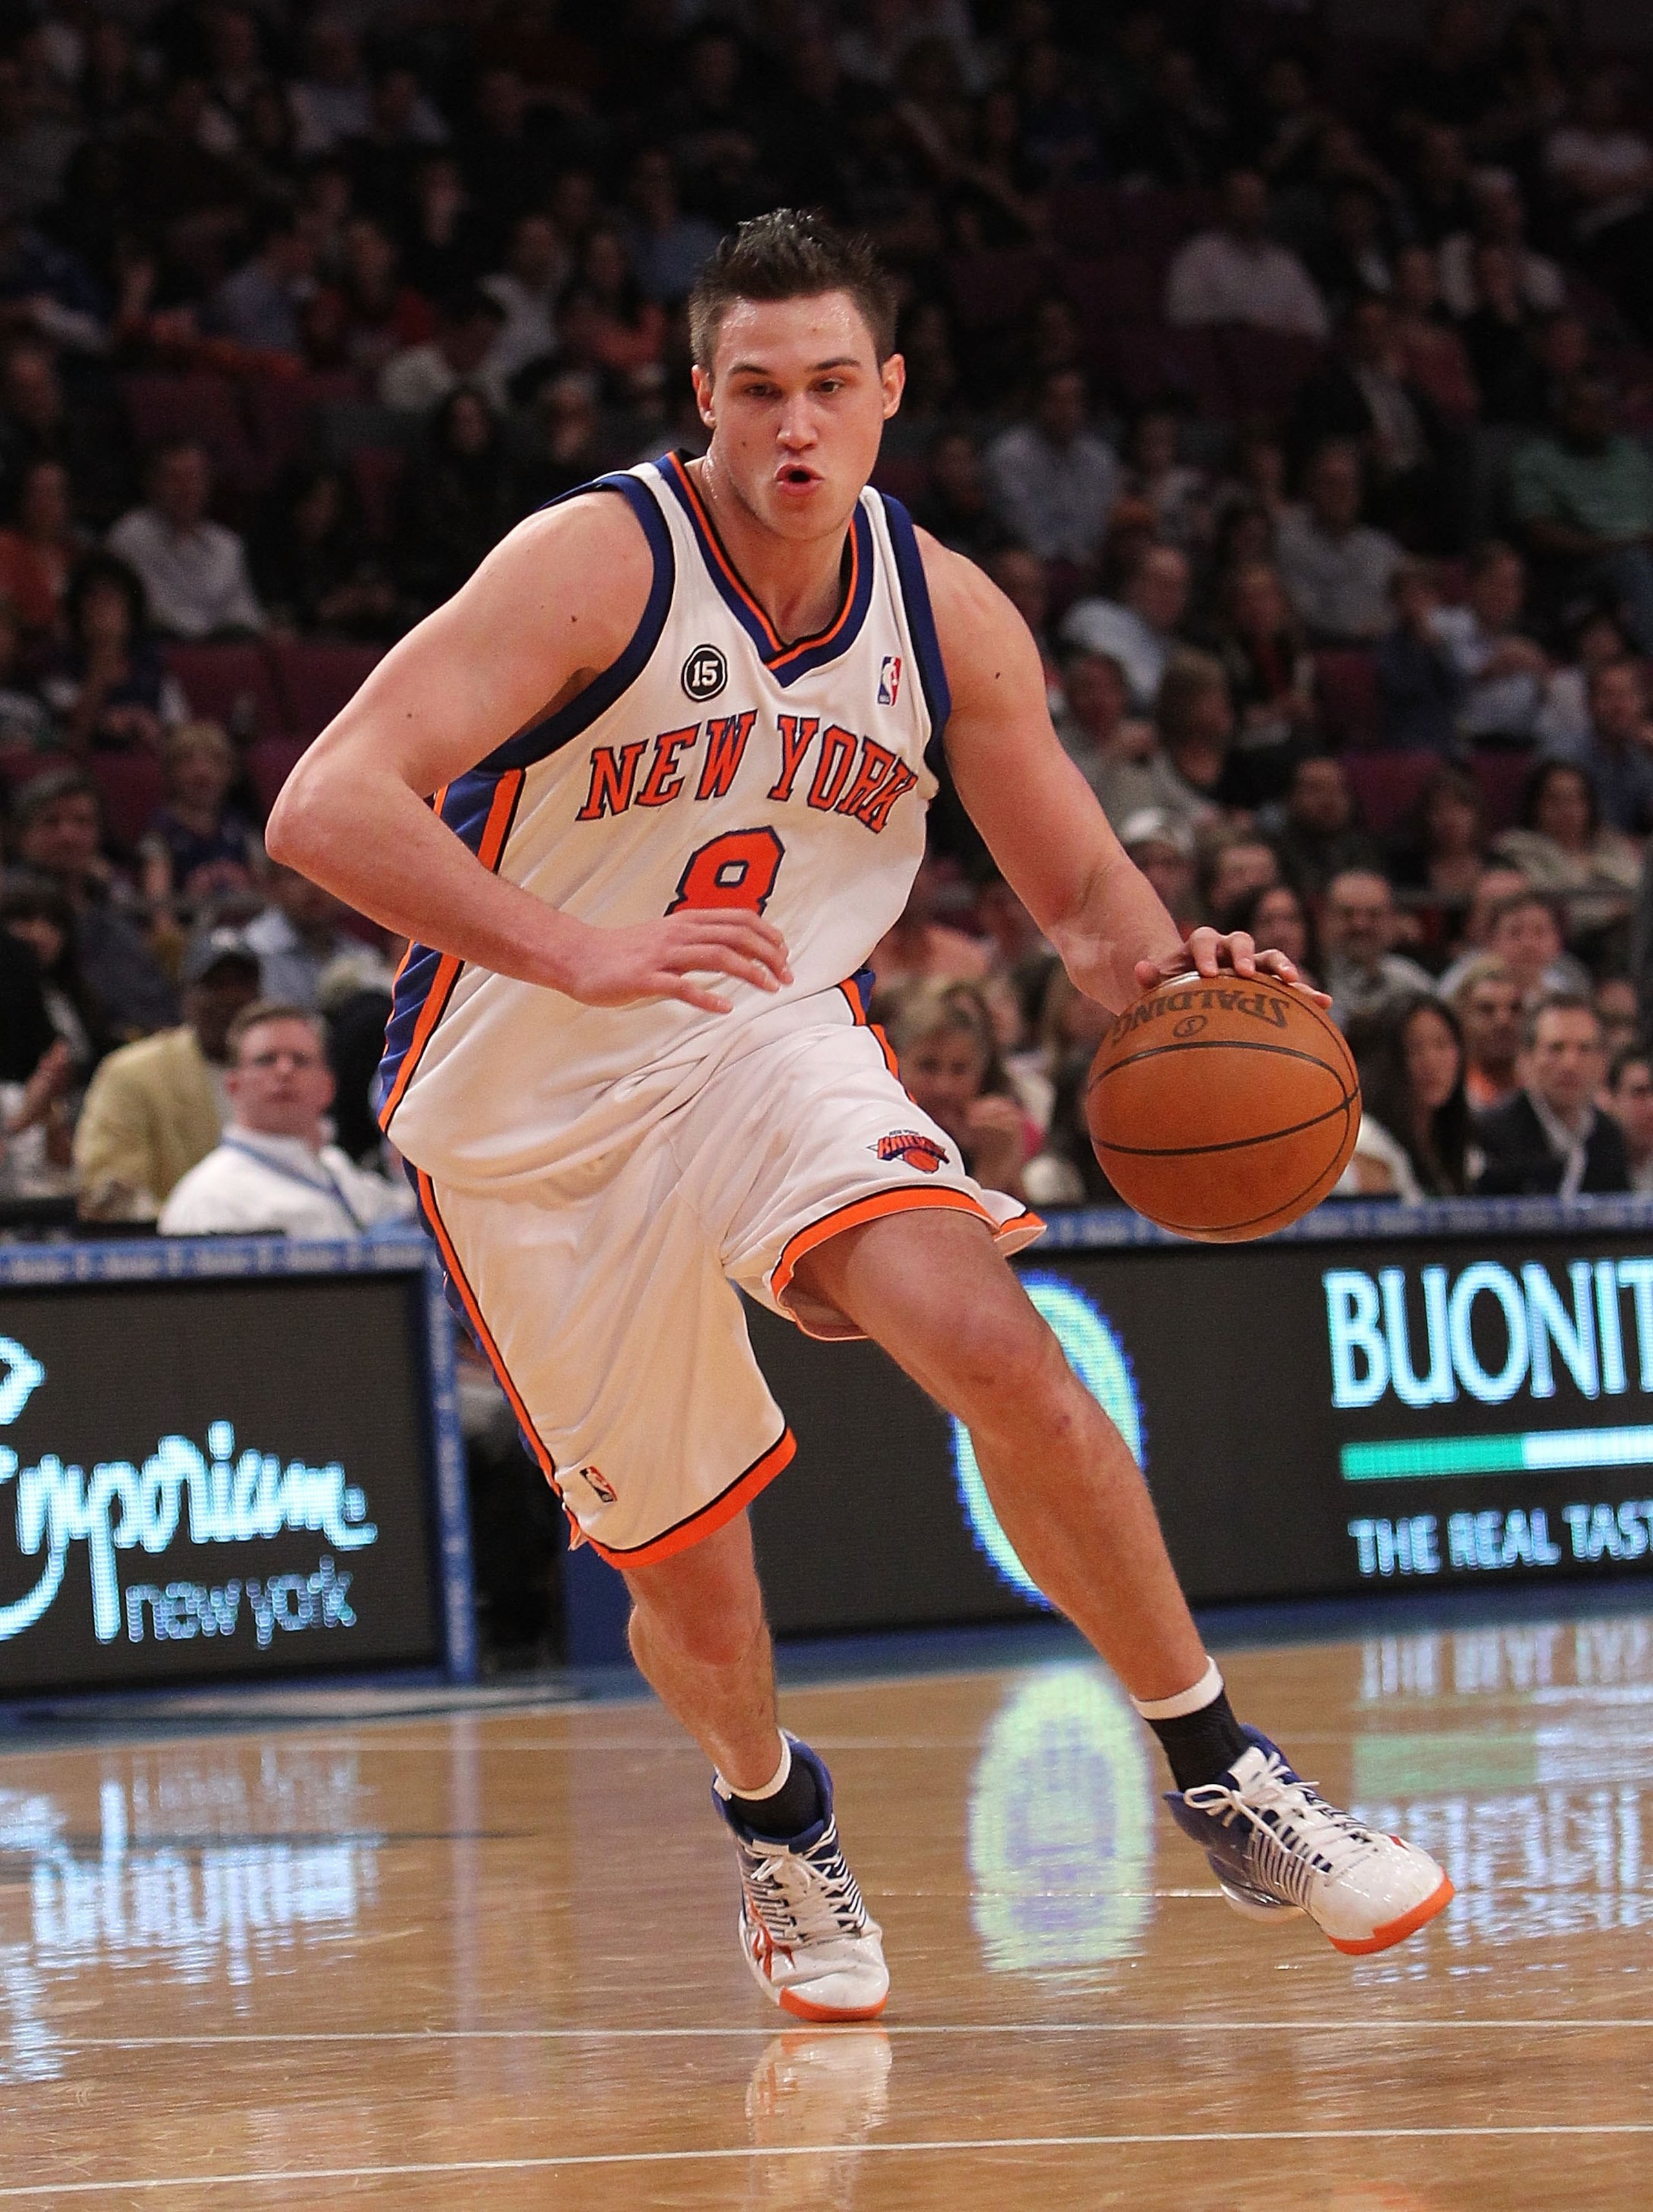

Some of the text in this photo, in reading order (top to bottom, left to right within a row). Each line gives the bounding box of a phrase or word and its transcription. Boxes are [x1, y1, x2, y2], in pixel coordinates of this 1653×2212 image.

[692, 659, 719, 687] 15
[575, 708, 919, 834] NEW YORK
[1111, 989, 1290, 1047] SPALDING
[1322, 1255, 1653, 1409] BUONIT
[1348, 1514, 1441, 1577] THE
[1447, 1507, 1563, 1571] REAL
[125, 1578, 243, 1641] new
